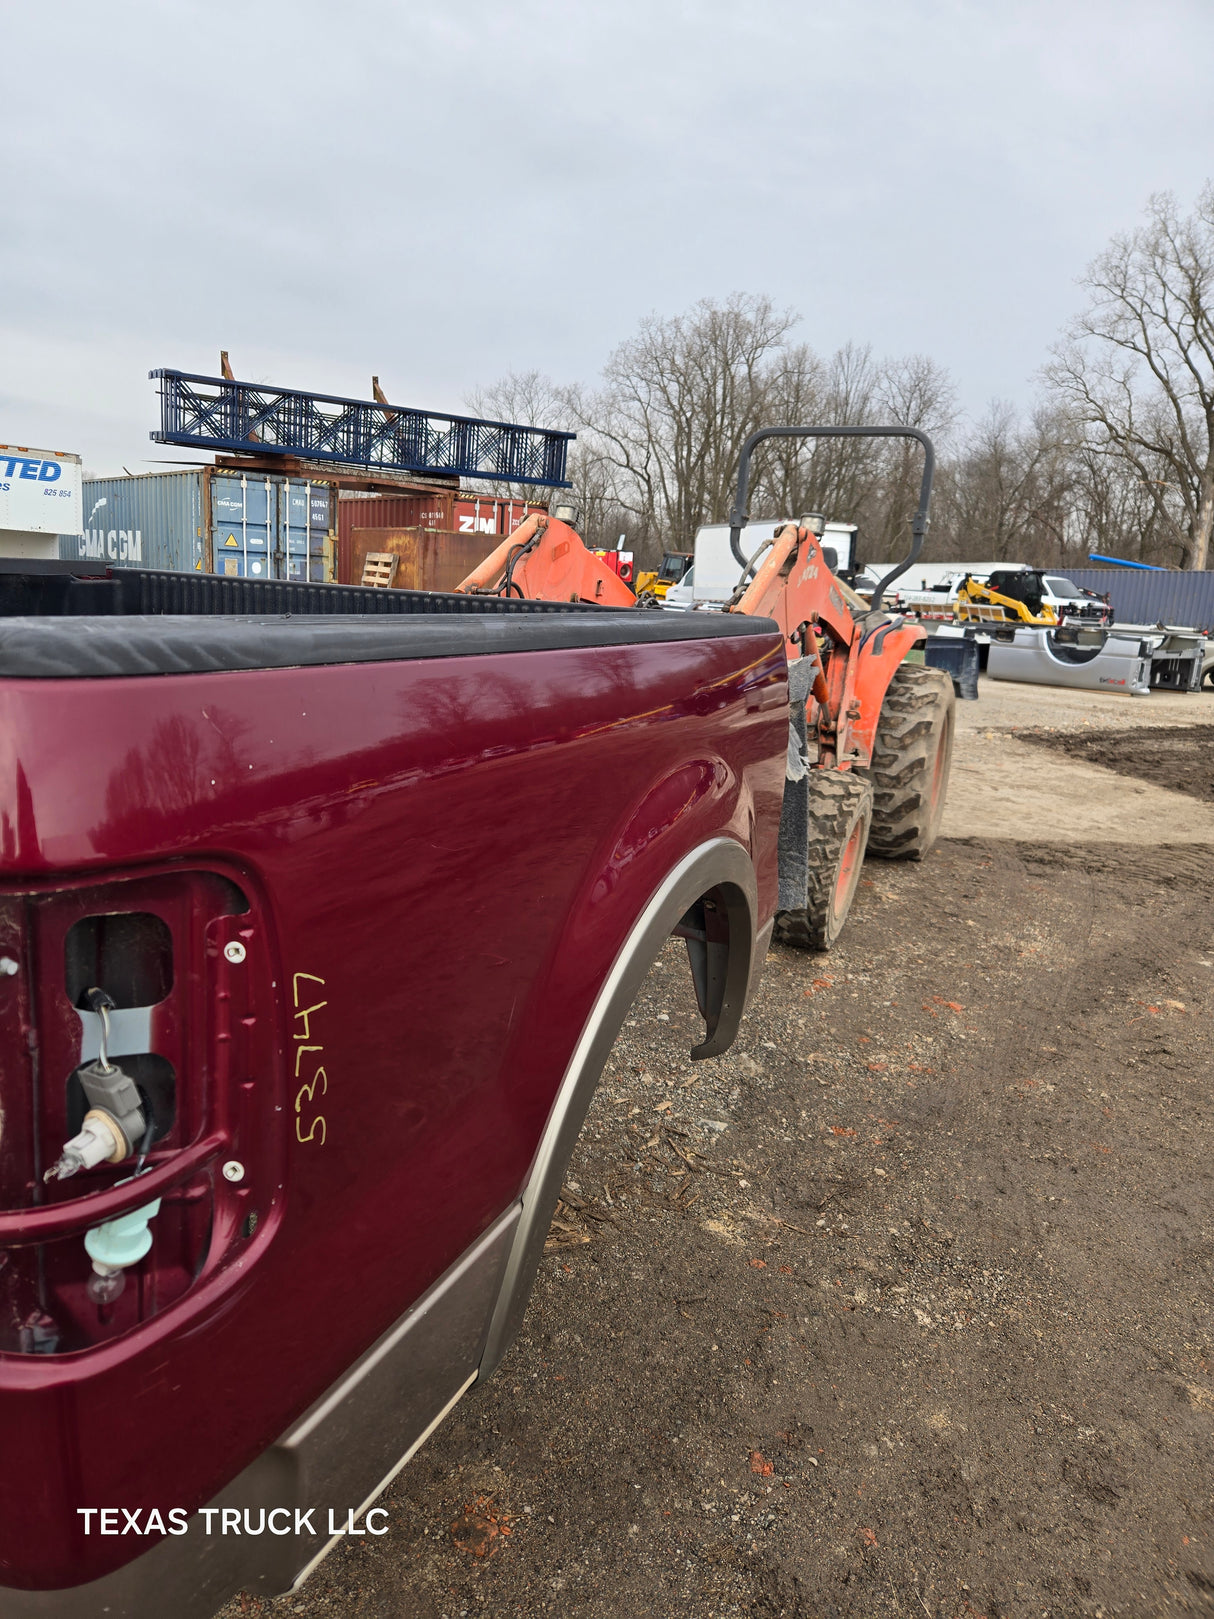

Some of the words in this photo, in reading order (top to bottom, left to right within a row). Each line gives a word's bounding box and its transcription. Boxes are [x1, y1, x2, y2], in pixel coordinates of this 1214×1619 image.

[43, 488, 58, 497] 825
[459, 515, 497, 534] ZIM
[78, 529, 105, 559] CMA
[107, 530, 142, 562] CGM
